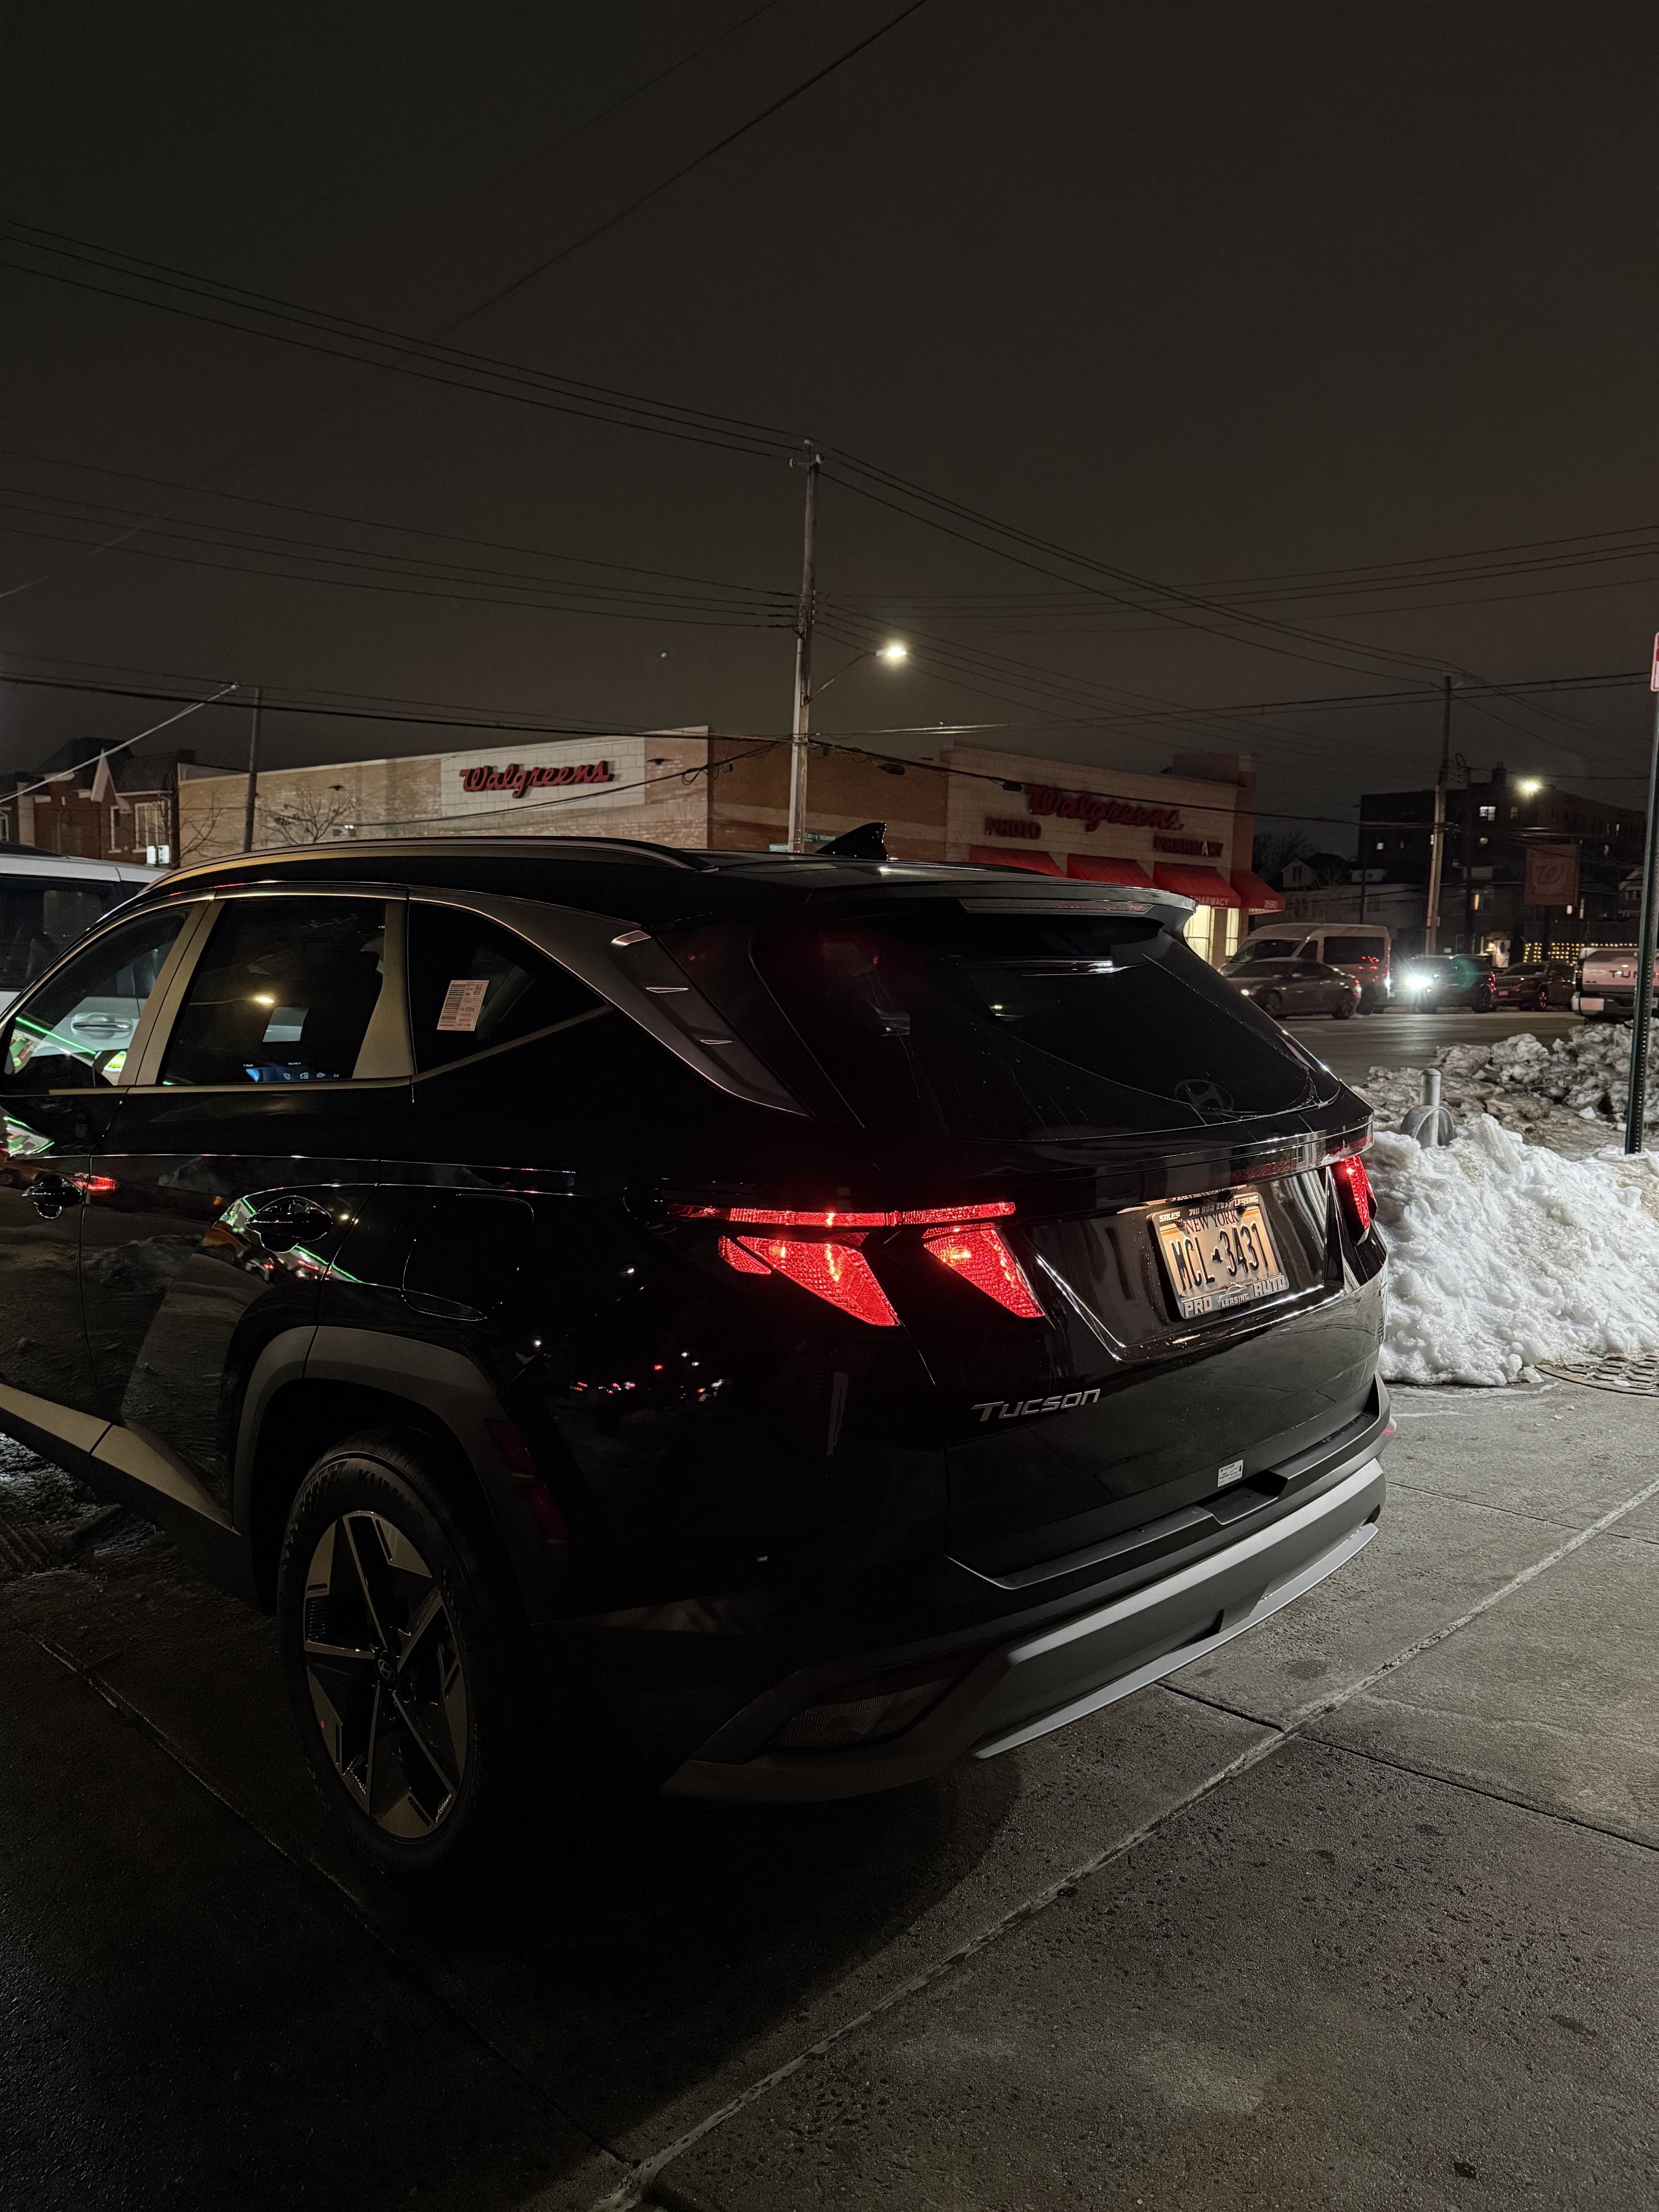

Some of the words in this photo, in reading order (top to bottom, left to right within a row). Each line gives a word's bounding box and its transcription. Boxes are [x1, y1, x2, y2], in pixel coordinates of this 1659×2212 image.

[459, 760, 614, 798] Walgreens
[1025, 784, 1184, 832] Walgreens
[986, 818, 1041, 839] PHOTO
[1154, 836, 1224, 858] PHARMACY
[1159, 1211, 1181, 1223] SALES
[1189, 1207, 1200, 1217] 718
[1234, 1195, 1259, 1207] LEASING
[1186, 1215, 1211, 1234] NEW
[1210, 1208, 1239, 1228] YORK
[1171, 1235, 1215, 1290] MCL
[1219, 1221, 1269, 1277] 3431
[1184, 1296, 1213, 1318] PRO
[1253, 1275, 1286, 1297] AUTO
[1221, 1294, 1249, 1307] LEASING
